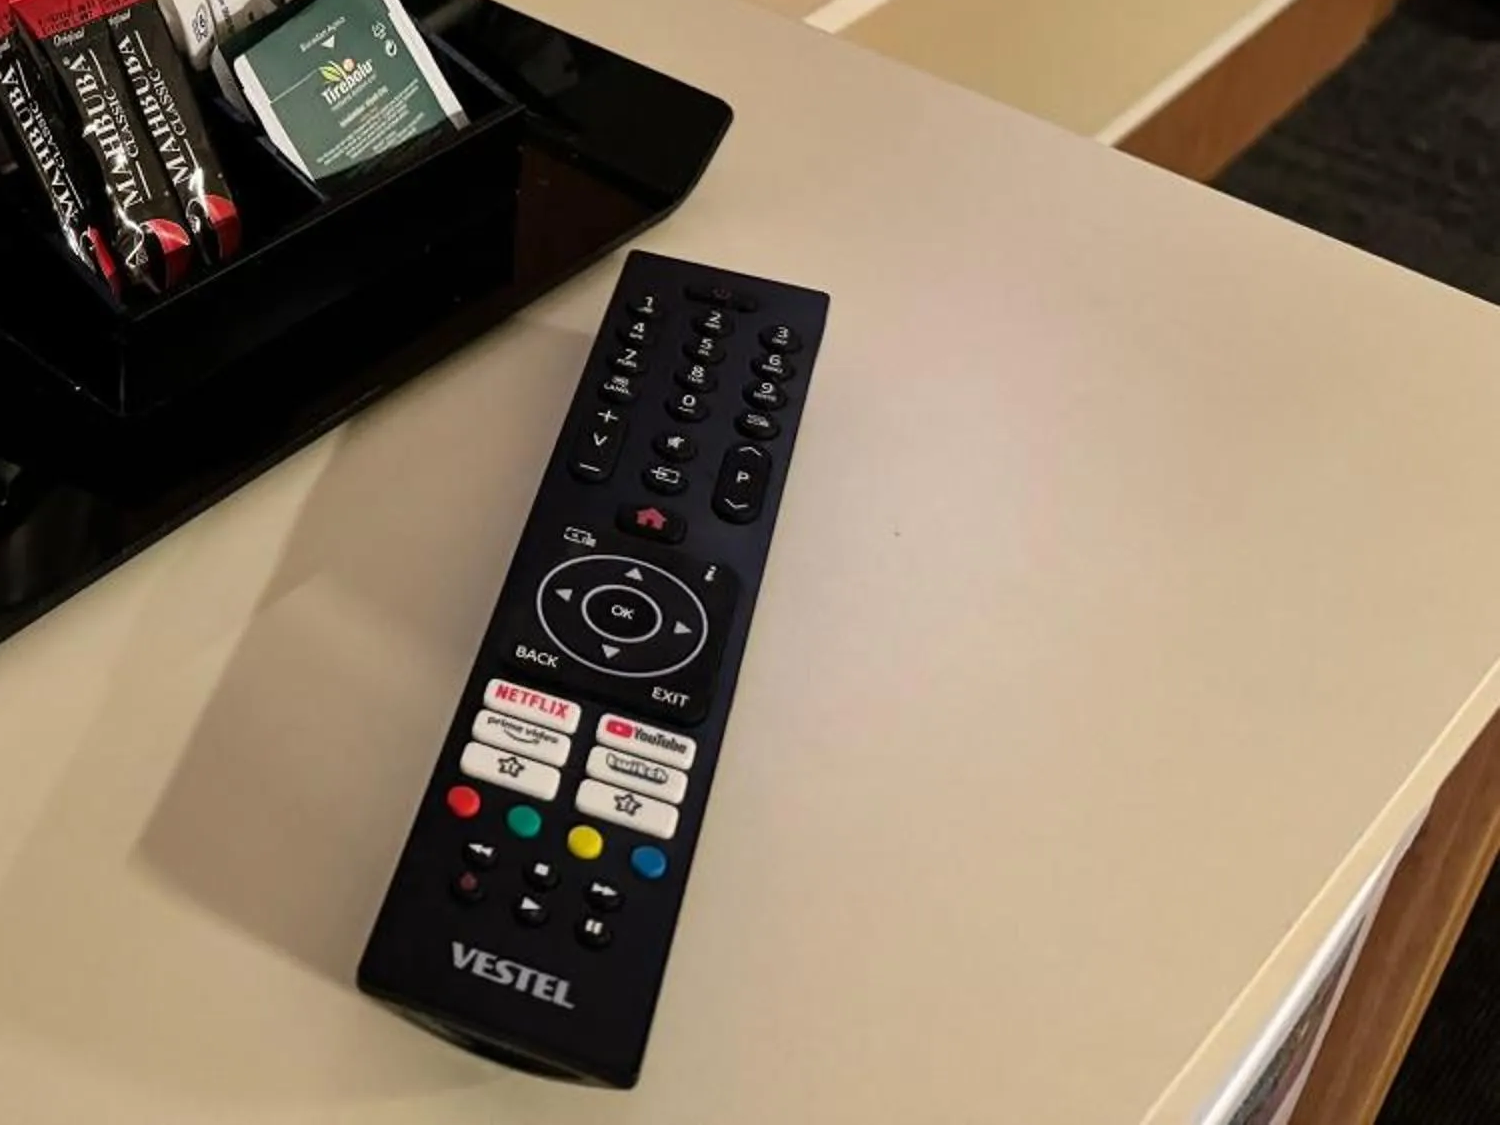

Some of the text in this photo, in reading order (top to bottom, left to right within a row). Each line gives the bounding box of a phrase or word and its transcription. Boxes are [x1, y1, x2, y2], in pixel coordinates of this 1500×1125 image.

[117, 35, 190, 187] MAHBUBA
[149, 69, 187, 136] CLASSIC
[104, 89, 139, 158] CLASSIC
[709, 310, 722, 323] 2
[632, 322, 645, 333] 4
[777, 326, 789, 338] 3
[700, 338, 713, 350] 5
[769, 354, 781, 366] 6
[691, 365, 705, 378] 8
[761, 382, 774, 394] 9
[682, 394, 696, 407] 0
[736, 472, 749, 484] P
[610, 603, 635, 621] OK
[515, 645, 560, 668] BACK
[495, 684, 569, 719] NETFLIX
[651, 686, 689, 708] EXIT
[487, 716, 559, 744] prime video
[634, 729, 687, 754] YouTube
[451, 941, 576, 1009] VESTEL
